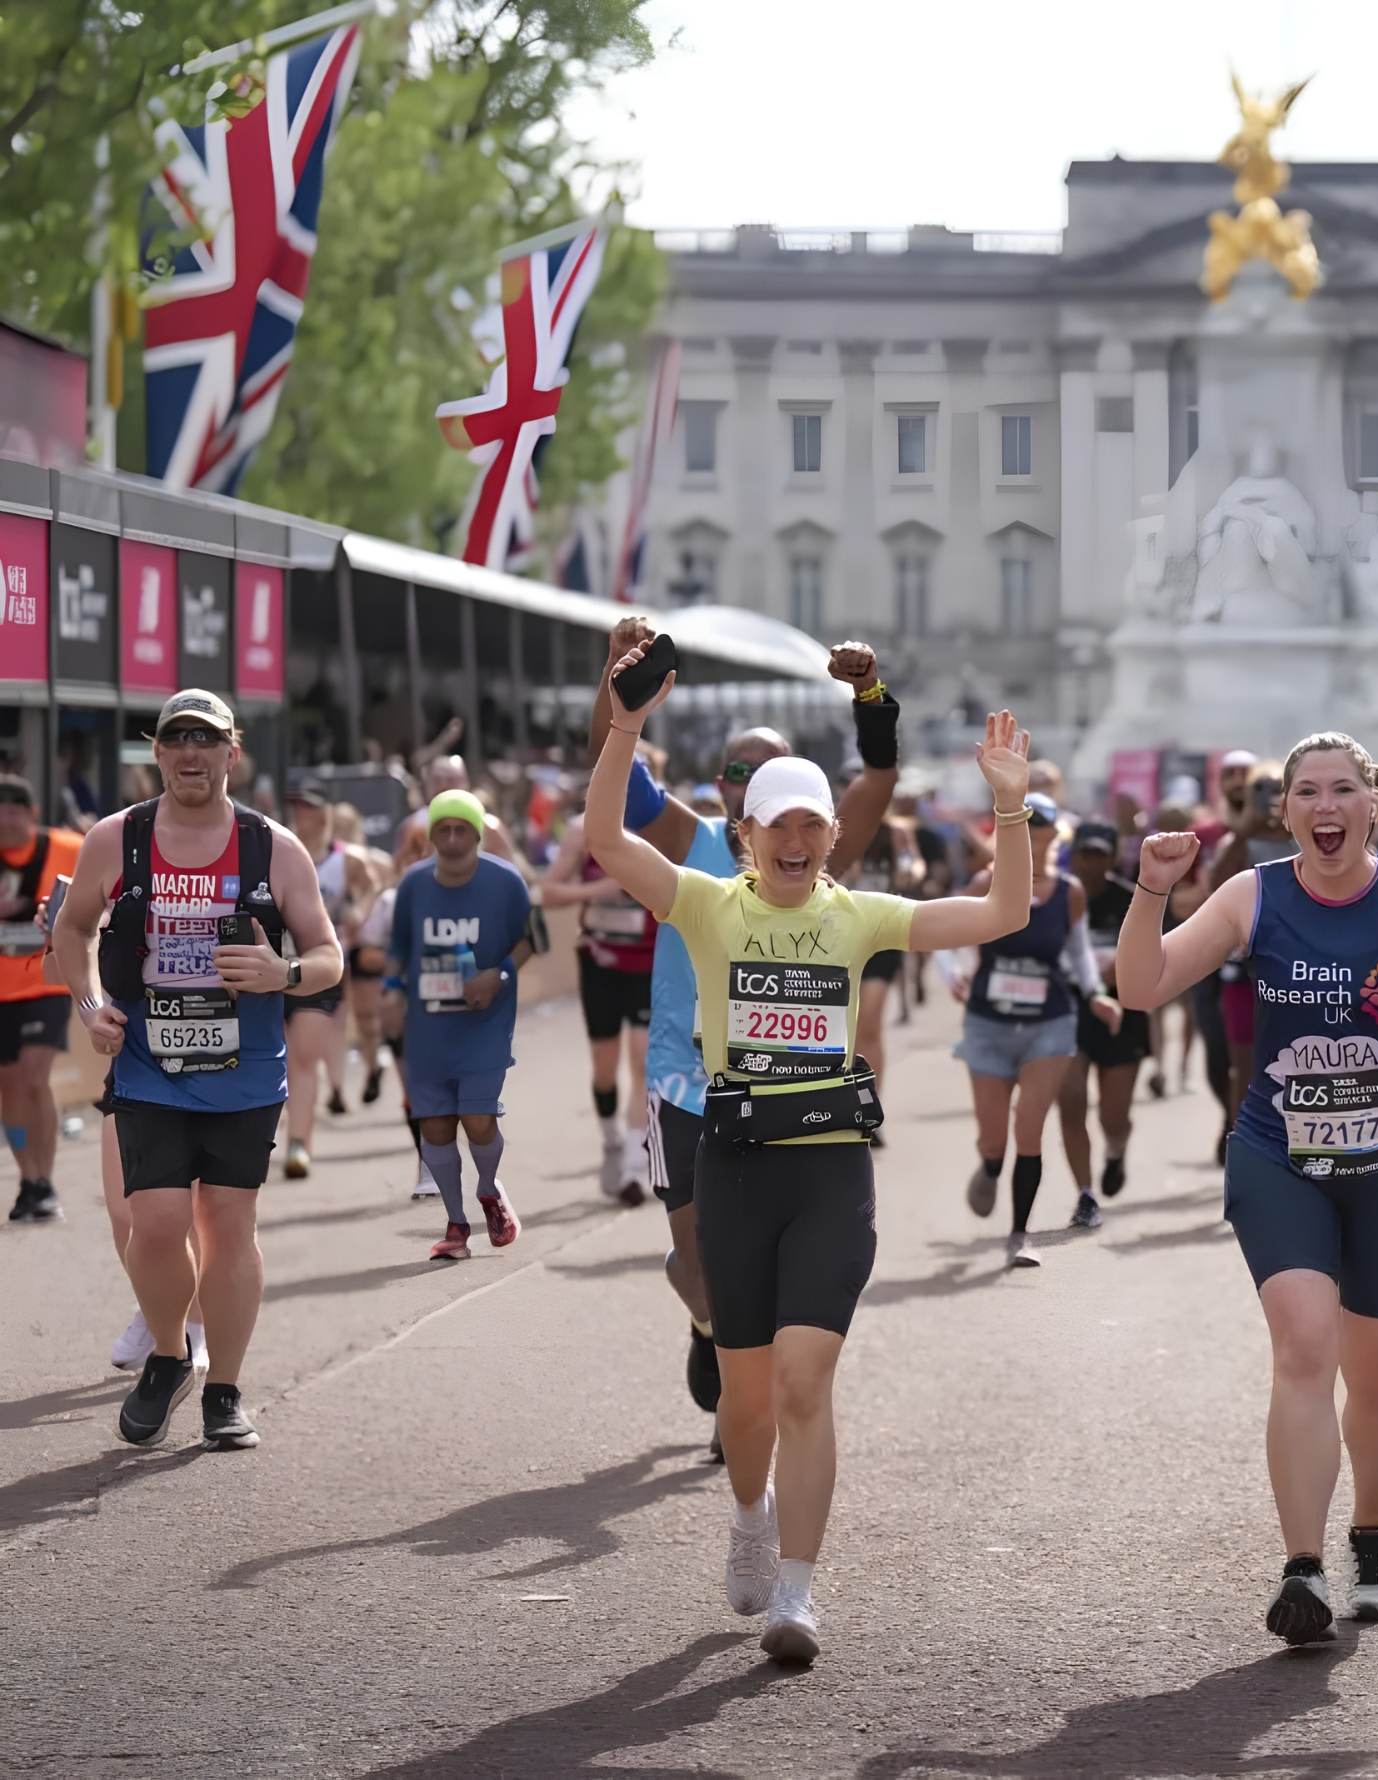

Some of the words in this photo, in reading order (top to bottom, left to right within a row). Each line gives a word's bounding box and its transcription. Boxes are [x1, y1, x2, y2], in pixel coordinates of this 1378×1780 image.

[152, 873, 216, 897] MARTIN
[424, 917, 480, 946] LDN
[743, 929, 828, 958] ALYX
[737, 968, 779, 995] tcs
[1292, 961, 1351, 981] Brain
[1258, 980, 1351, 1005] Research
[747, 1012, 827, 1041] 22996
[1324, 1007, 1352, 1024] UK
[161, 1028, 223, 1048] 65235
[1294, 1042, 1378, 1069] MAURA
[1290, 1080, 1328, 1106] tcs
